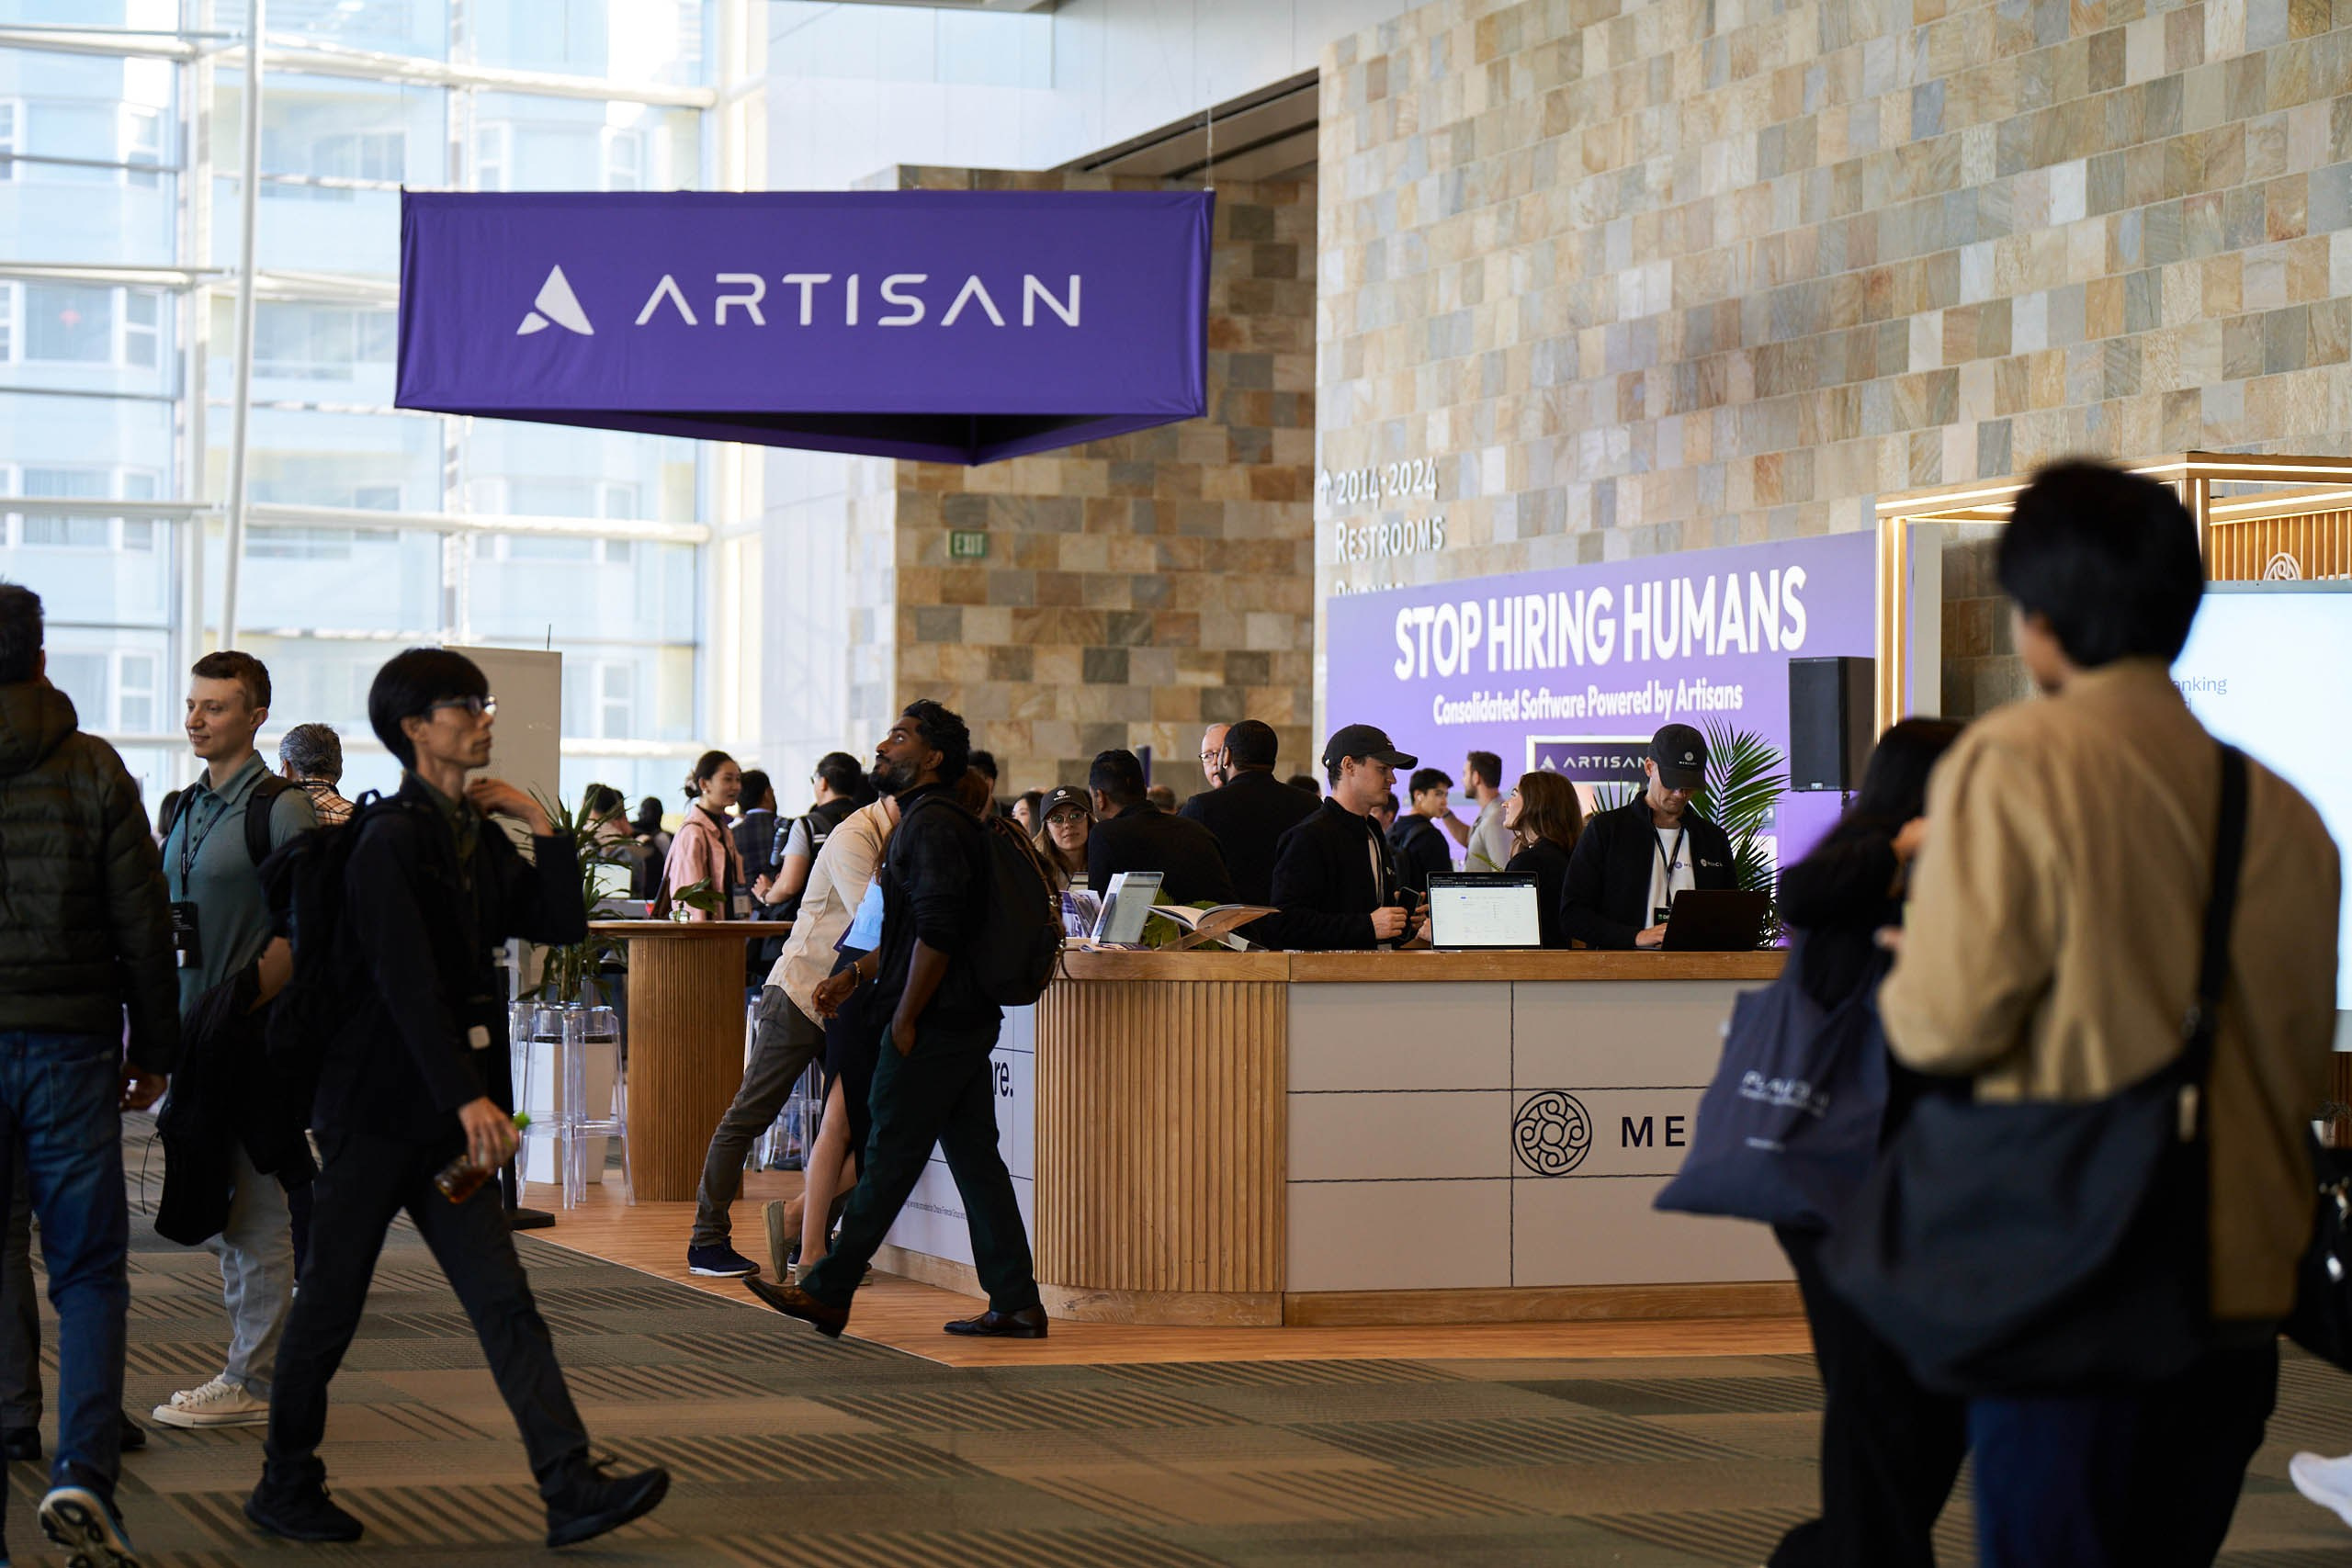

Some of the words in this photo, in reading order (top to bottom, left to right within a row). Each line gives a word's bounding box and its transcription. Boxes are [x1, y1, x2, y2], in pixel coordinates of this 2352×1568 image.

[635, 274, 1081, 327] ARTISAN
[1394, 601, 1482, 681] STOP
[1487, 586, 1616, 672] HIRING
[1623, 565, 1807, 662] HUMANS
[1433, 689, 1519, 726] Consolidated
[1521, 687, 1586, 721] Software
[1588, 680, 1652, 717] Powered
[1654, 680, 1673, 720] by
[1675, 677, 1743, 712] Artisans
[2172, 676, 2227, 695] anking
[1622, 1115, 1686, 1147] ME
